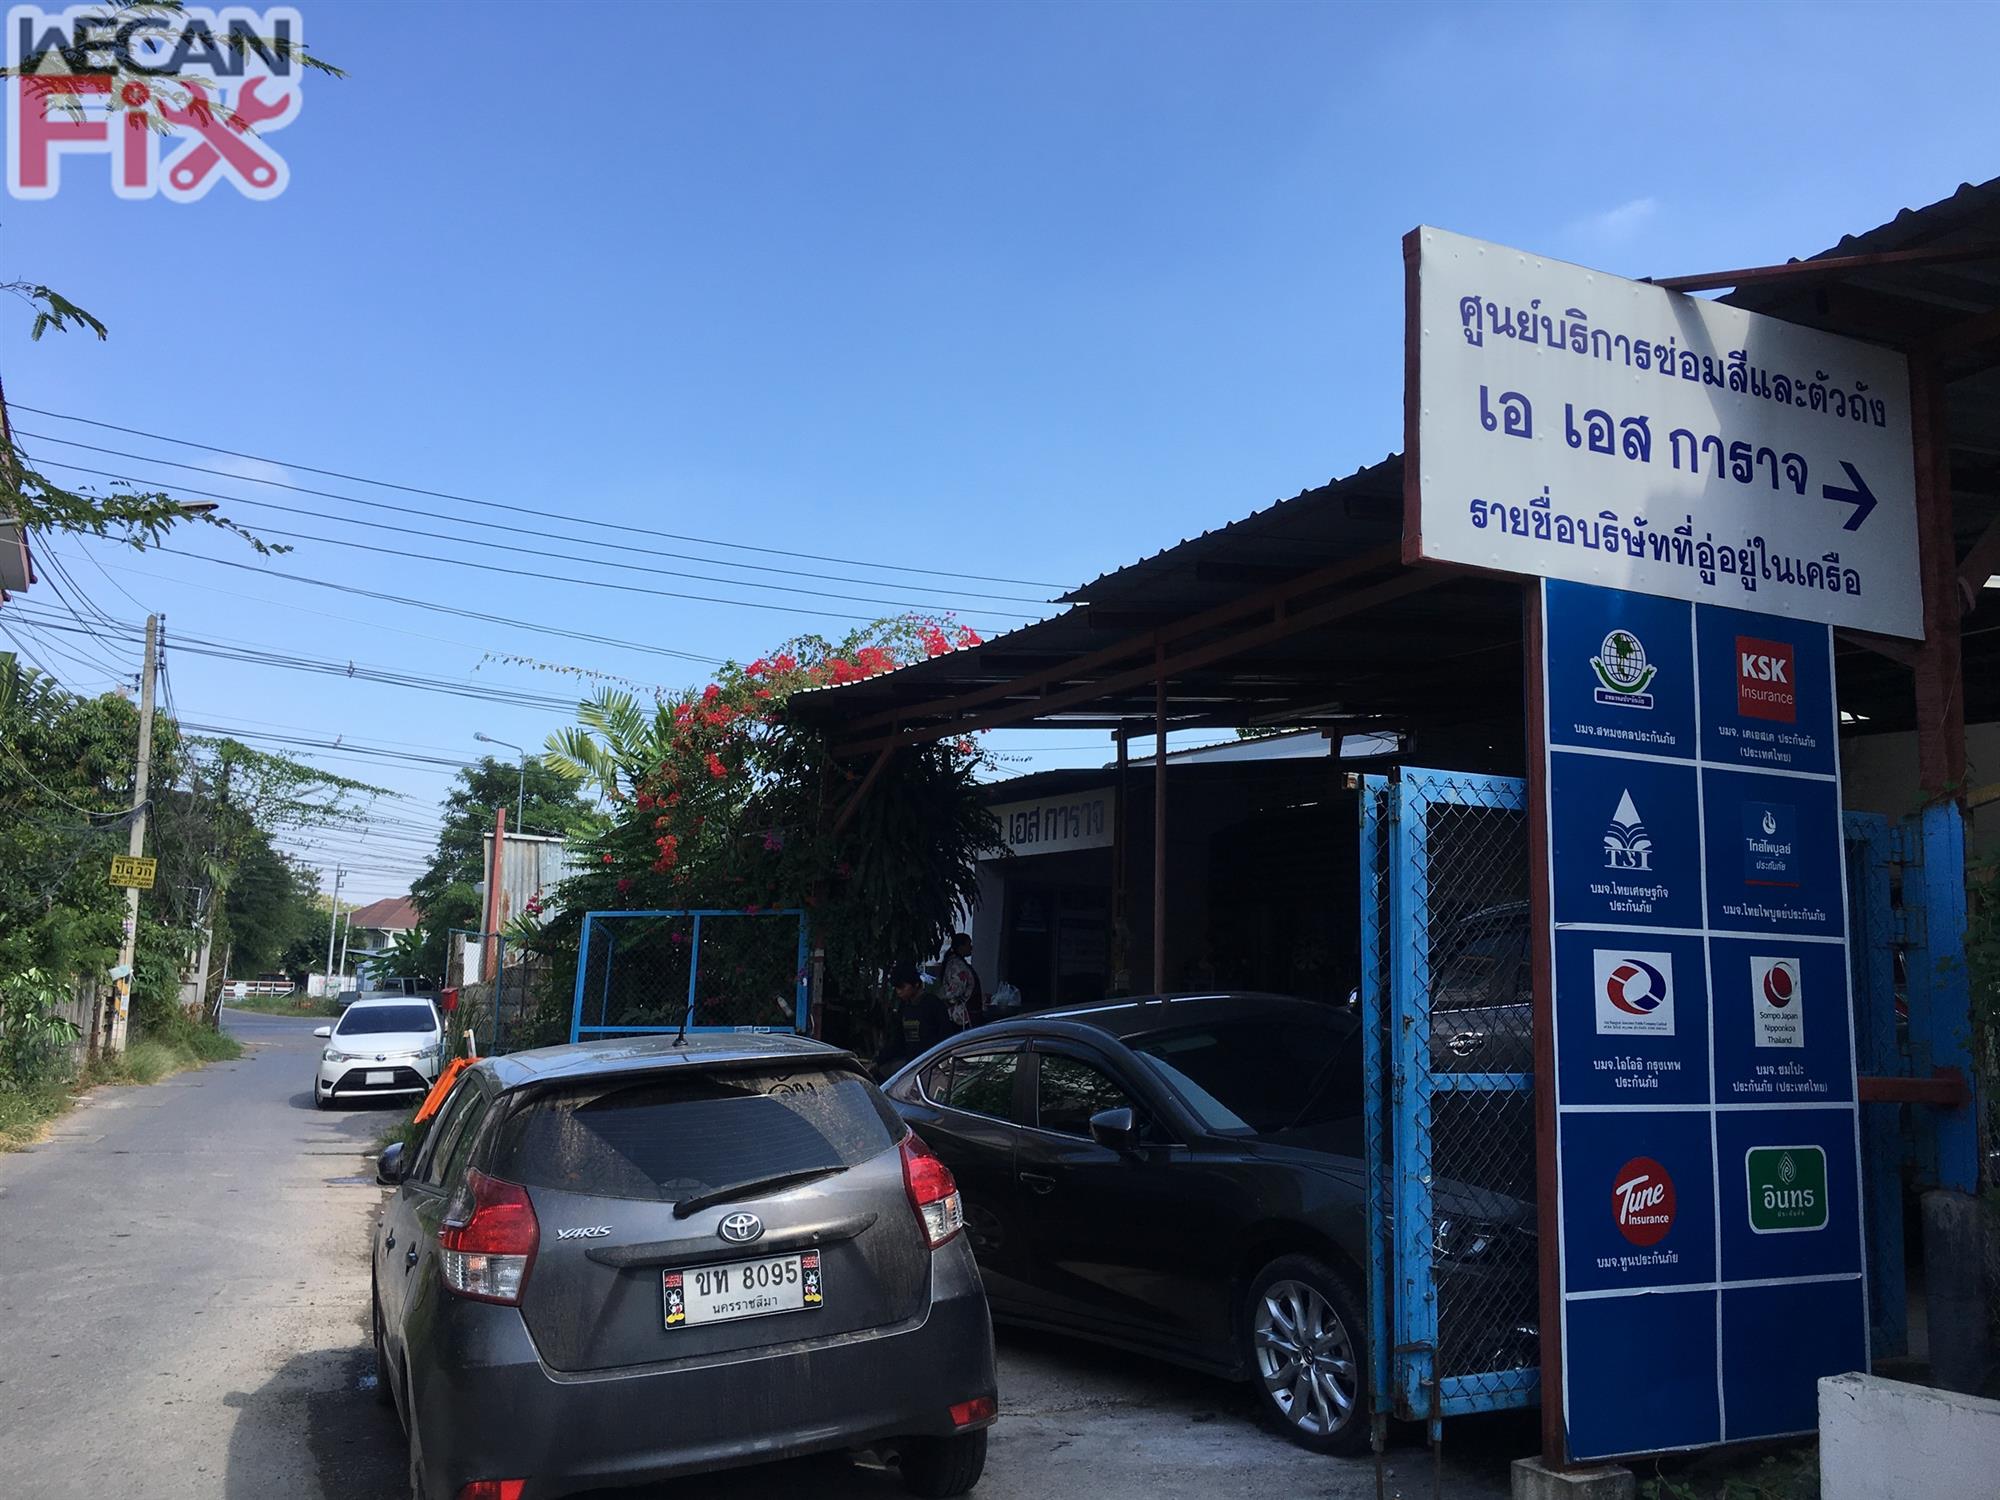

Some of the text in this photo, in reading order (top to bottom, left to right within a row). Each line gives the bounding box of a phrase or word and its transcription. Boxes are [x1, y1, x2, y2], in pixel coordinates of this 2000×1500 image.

[1460, 294, 1887, 427] ศูนย์บริการซ่อมสีและตัวถัง
[1479, 384, 1807, 497] เอ เอส การาจ
[1470, 486, 1861, 596] รายชื่อบริษัทที่อู่อยู่ในเครือ
[1741, 652, 1787, 684] KSK
[1741, 684, 1793, 705] Insurance
[1009, 807, 1041, 845] เอส
[1044, 800, 1105, 841] การาจ
[1605, 849, 1651, 870] TSI
[1610, 899, 1652, 913] ประกันภัย
[1759, 1011, 1798, 1022] Sompo Japan
[1767, 1035, 1793, 1044] Thailand
[1646, 1060, 1681, 1075] กรุงเทพ
[1615, 1074, 1658, 1088] ประกันภัย
[1732, 1079, 1773, 1092] ประกันภัย
[1615, 1174, 1665, 1225] Tune
[1762, 1184, 1815, 1209] อินทร
[1628, 1214, 1670, 1225] Insurance
[556, 1225, 613, 1240] YARIS
[695, 1268, 730, 1297] ขท
[742, 1260, 799, 1291] 8095
[712, 1294, 778, 1315] นครราชสีมา
